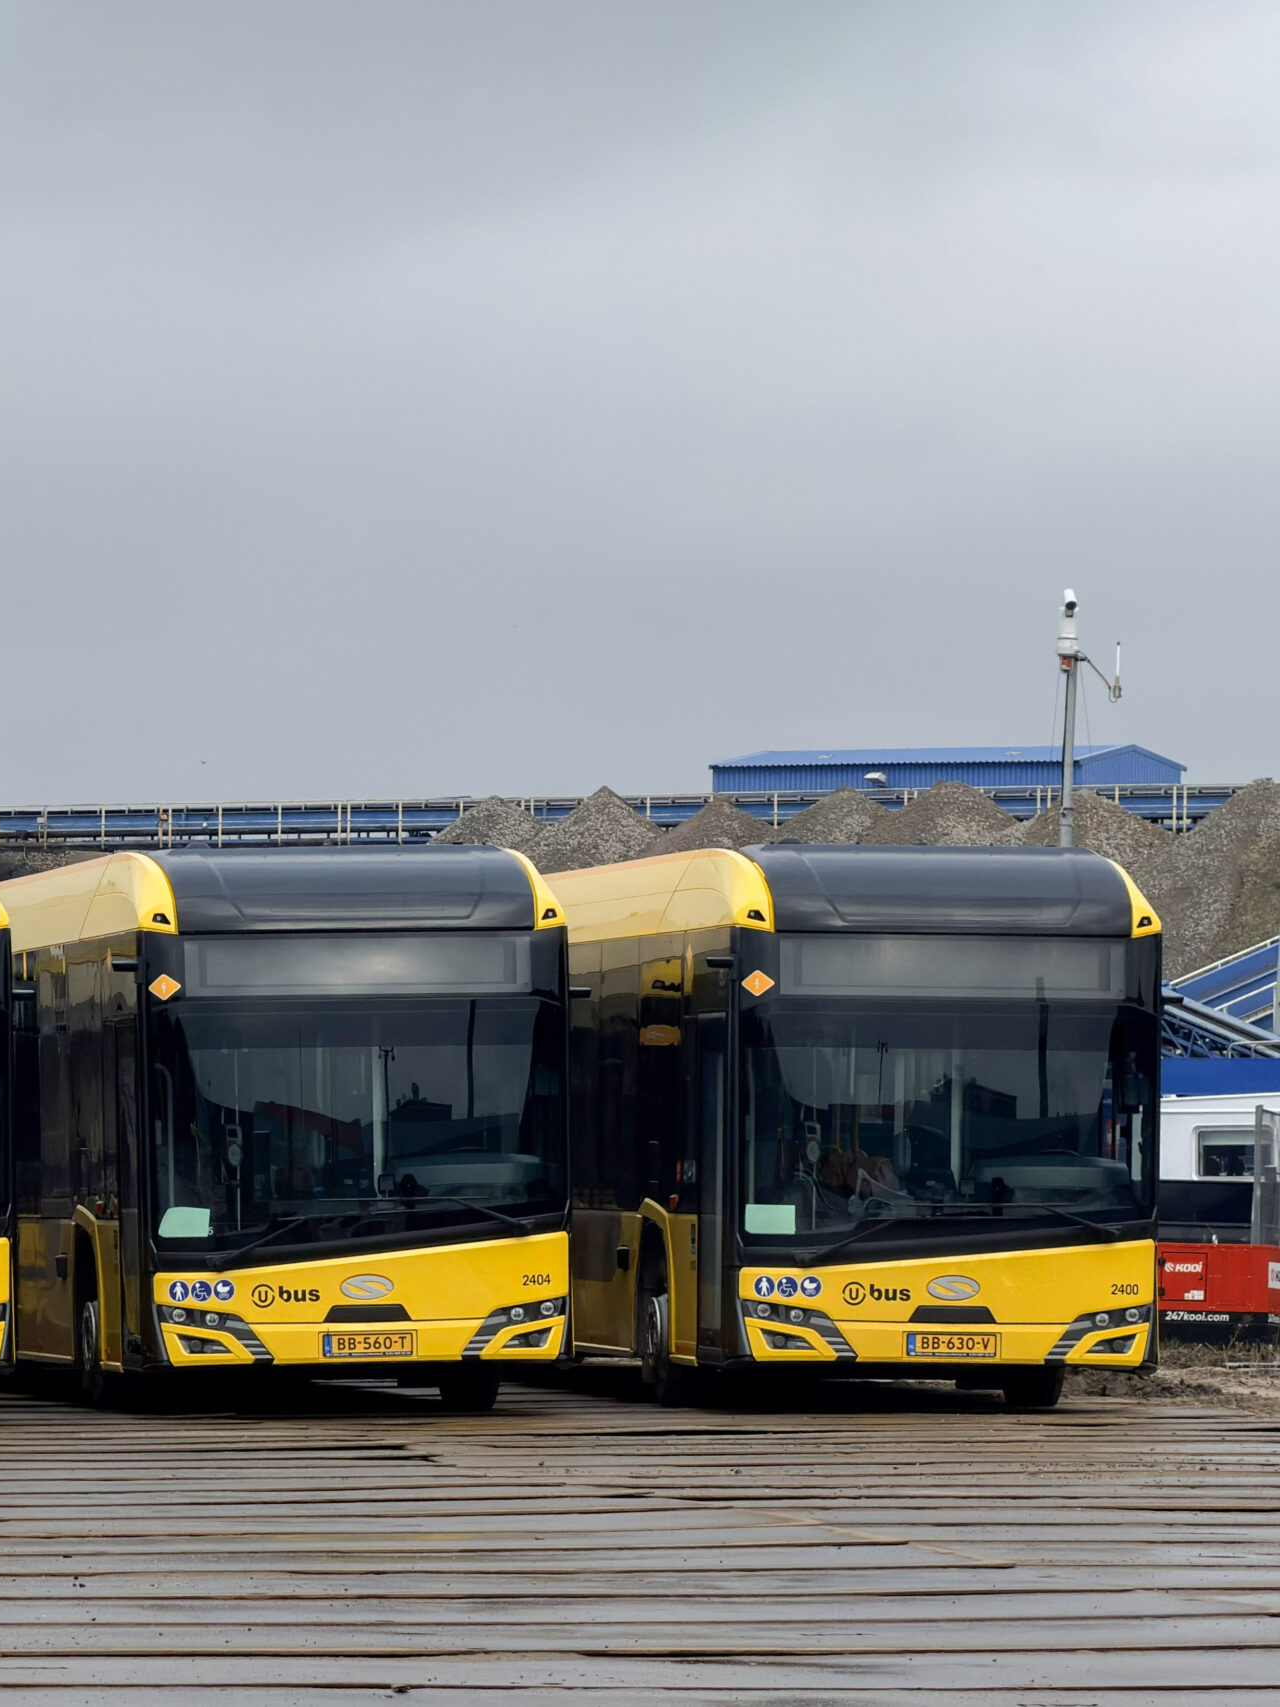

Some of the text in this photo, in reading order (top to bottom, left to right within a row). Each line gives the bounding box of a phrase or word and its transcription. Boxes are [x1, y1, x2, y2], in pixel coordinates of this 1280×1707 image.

[522, 1274, 551, 1286] 2404
[278, 1285, 321, 1303] bus
[869, 1283, 911, 1302] bus
[1111, 1283, 1139, 1296] 2400
[337, 1336, 407, 1351] BB-560-T
[921, 1336, 990, 1351] BB-630-V
